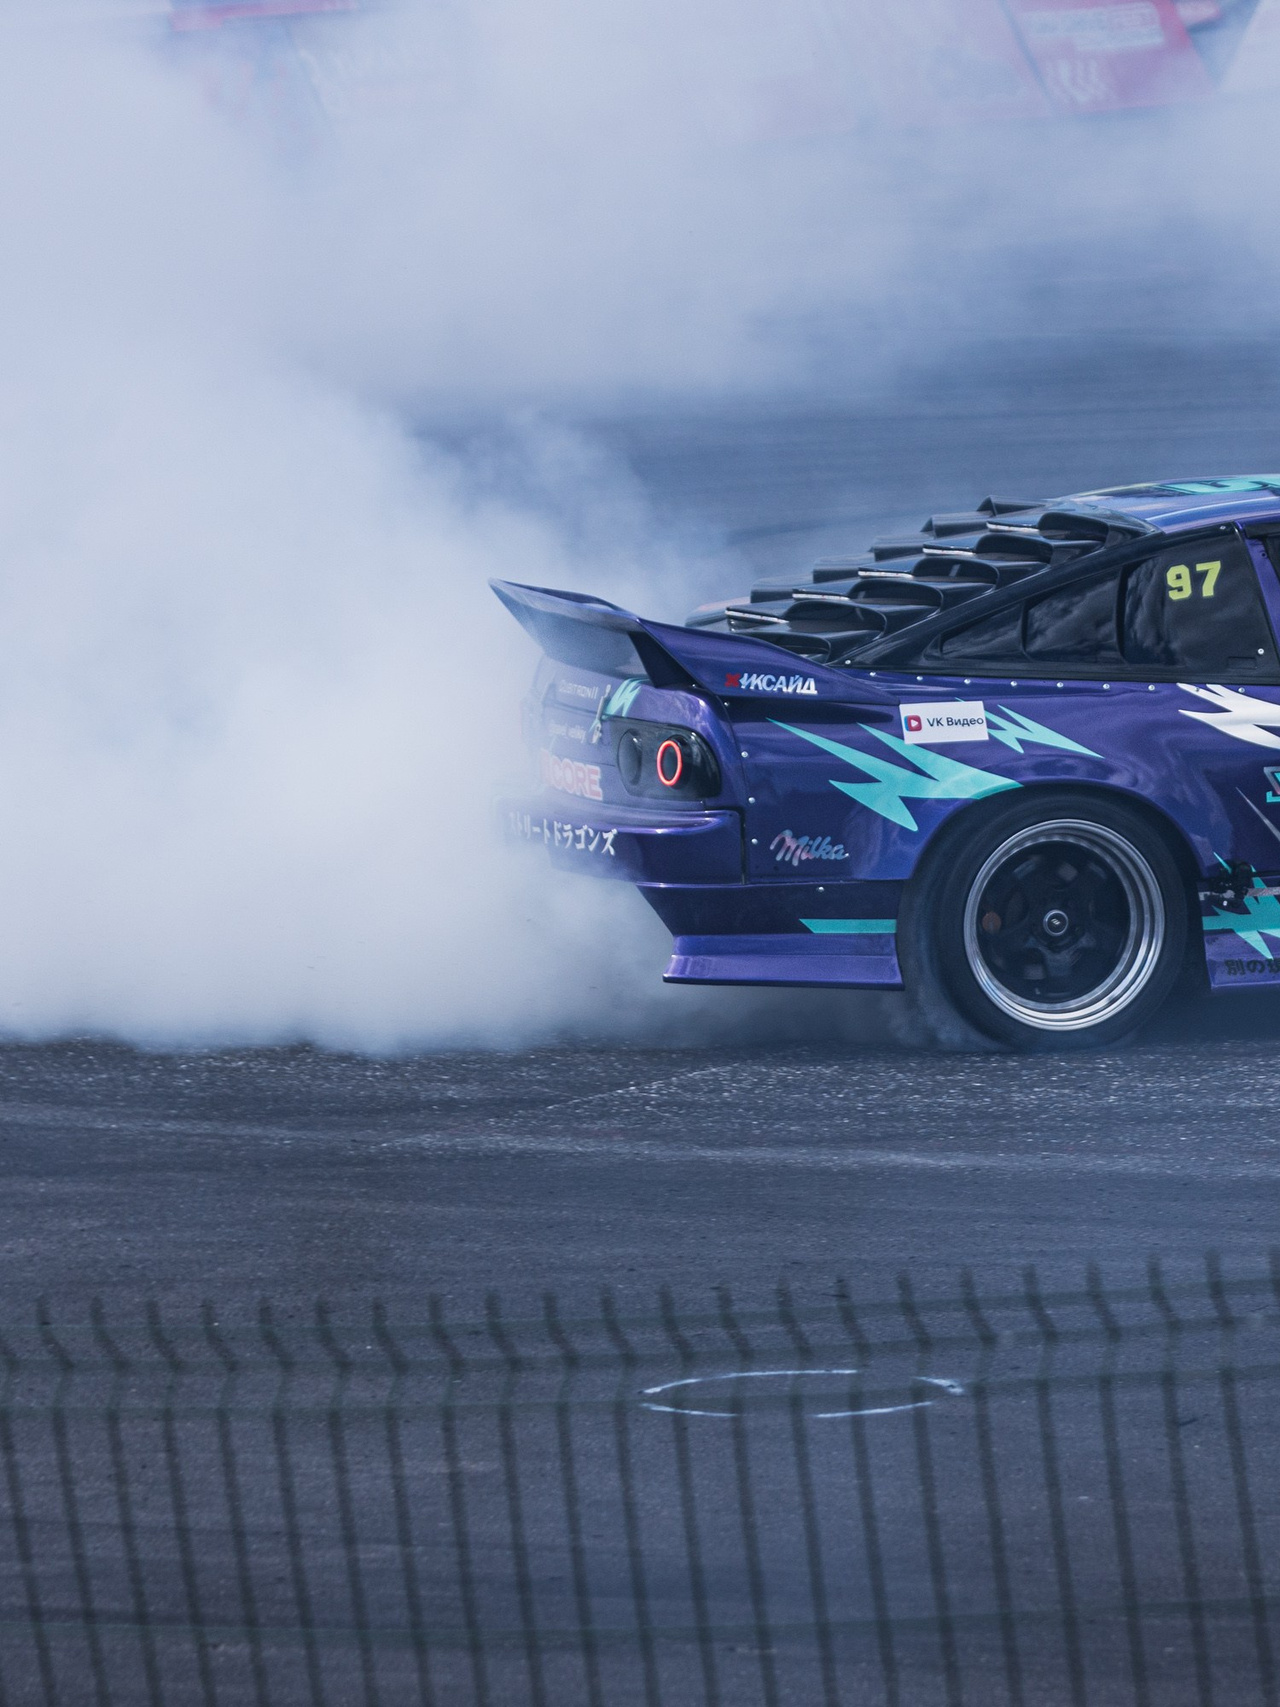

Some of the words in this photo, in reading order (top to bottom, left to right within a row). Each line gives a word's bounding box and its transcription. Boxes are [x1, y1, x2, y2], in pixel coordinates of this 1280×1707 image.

[1166, 560, 1221, 600] 97
[926, 717, 944, 728] VK
[946, 716, 985, 728] Видео
[769, 829, 849, 867] Milka
